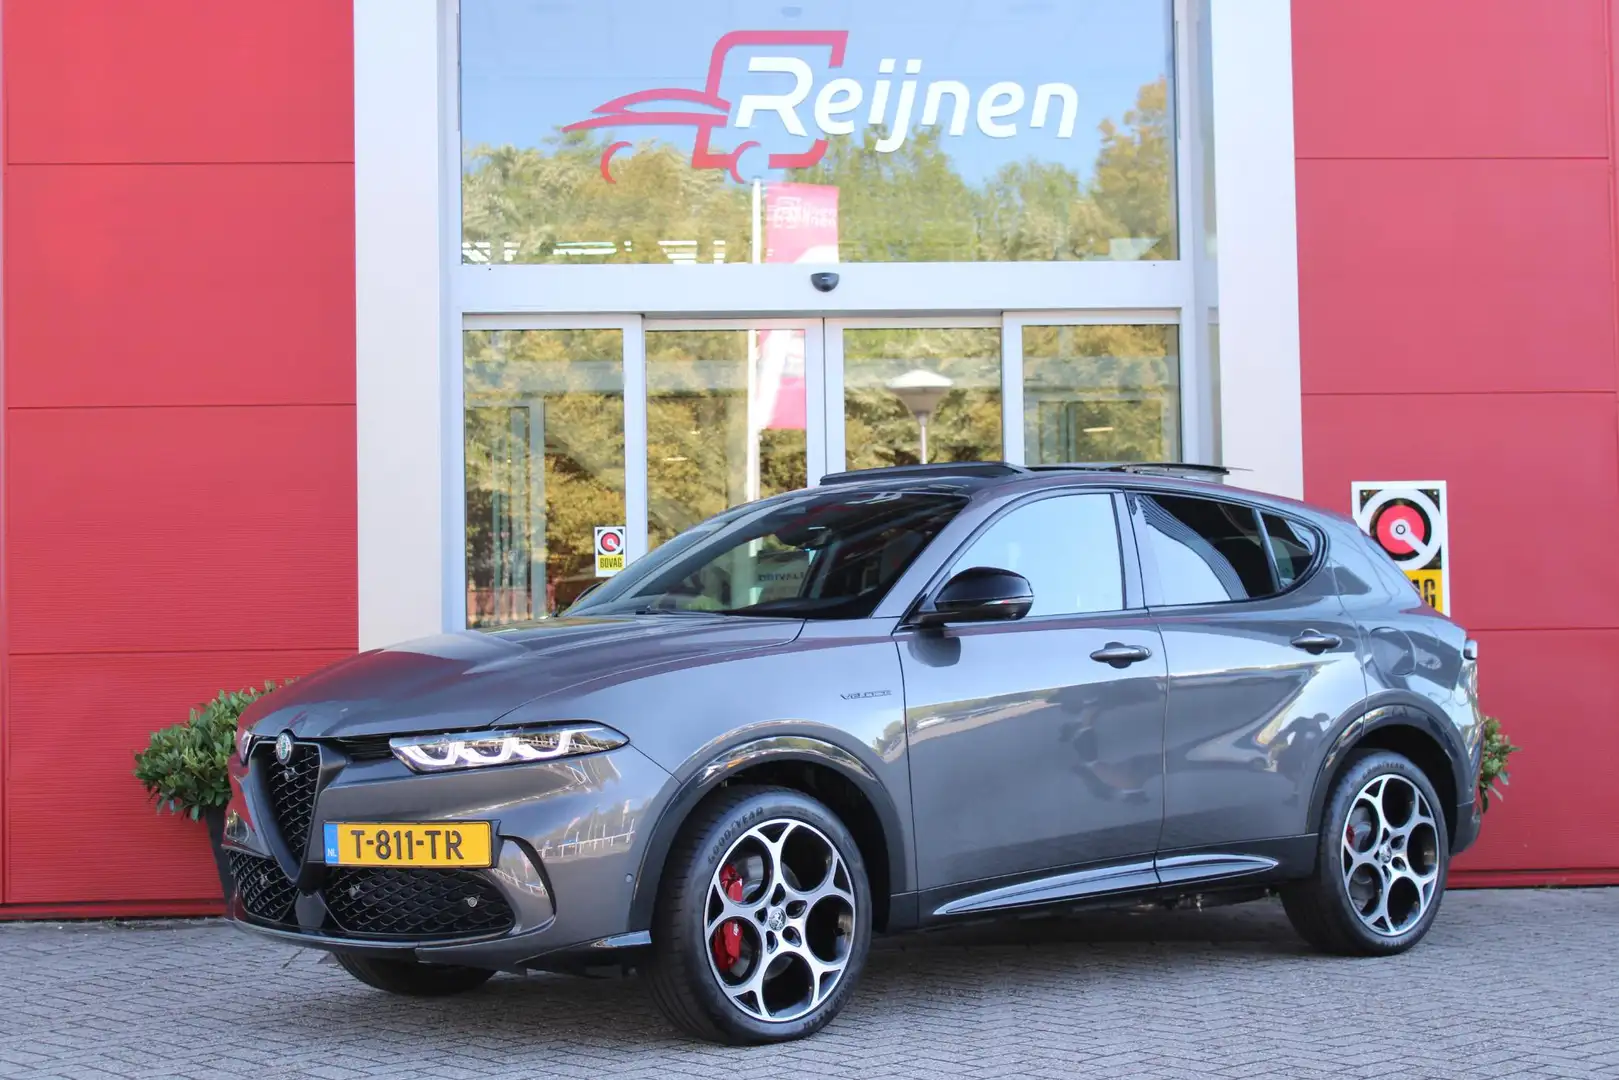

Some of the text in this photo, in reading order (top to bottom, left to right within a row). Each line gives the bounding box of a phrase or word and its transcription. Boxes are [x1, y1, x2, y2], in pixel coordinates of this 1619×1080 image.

[734, 57, 1079, 153] Reijnen
[327, 848, 337, 857] NL
[350, 829, 465, 861] T-811-TR
